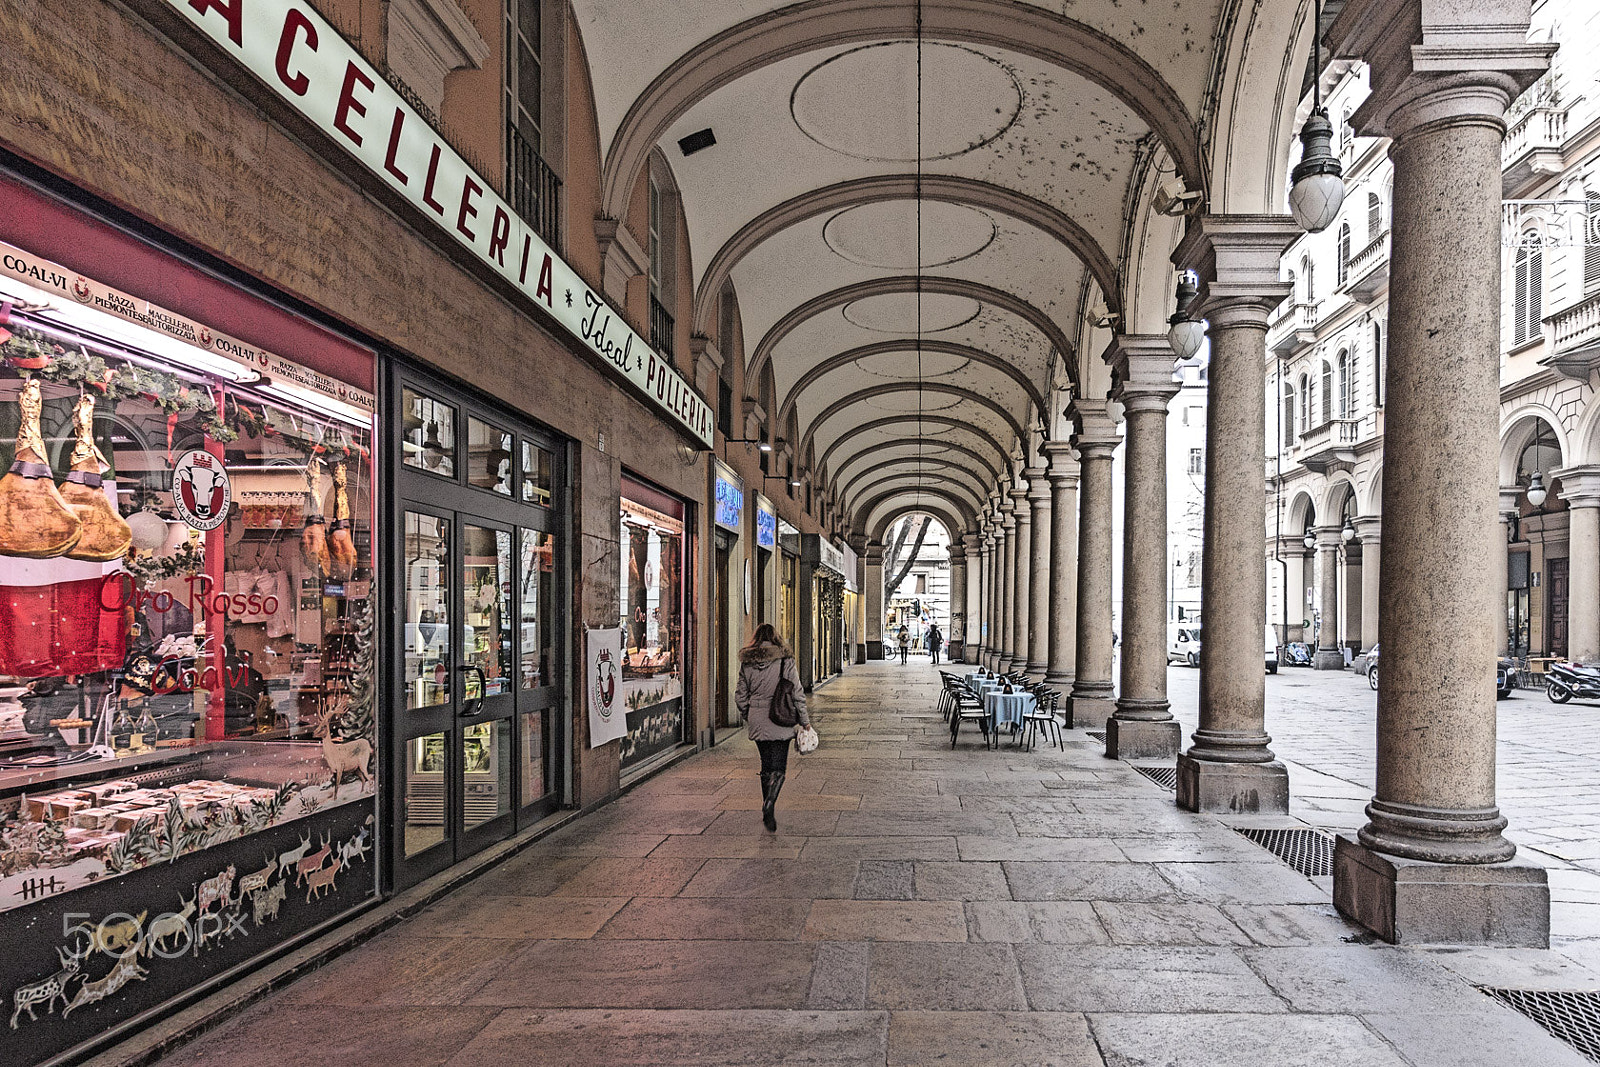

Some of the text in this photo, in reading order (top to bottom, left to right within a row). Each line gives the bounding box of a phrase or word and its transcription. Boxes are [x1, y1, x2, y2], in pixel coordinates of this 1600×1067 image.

[95, 296, 149, 324] PIEMONTESE
[108, 292, 136, 311] RAZZA
[147, 317, 197, 342] AUTORIZZATA
[148, 309, 195, 333] MACELLERIA
[279, 361, 298, 374] RAZZA
[581, 290, 633, 373] Ideal
[646, 355, 707, 438] POLLERIA
[186, 513, 208, 529] RAZZA
[100, 569, 279, 617] Oro Rosso
[151, 645, 250, 694] Coalvi
